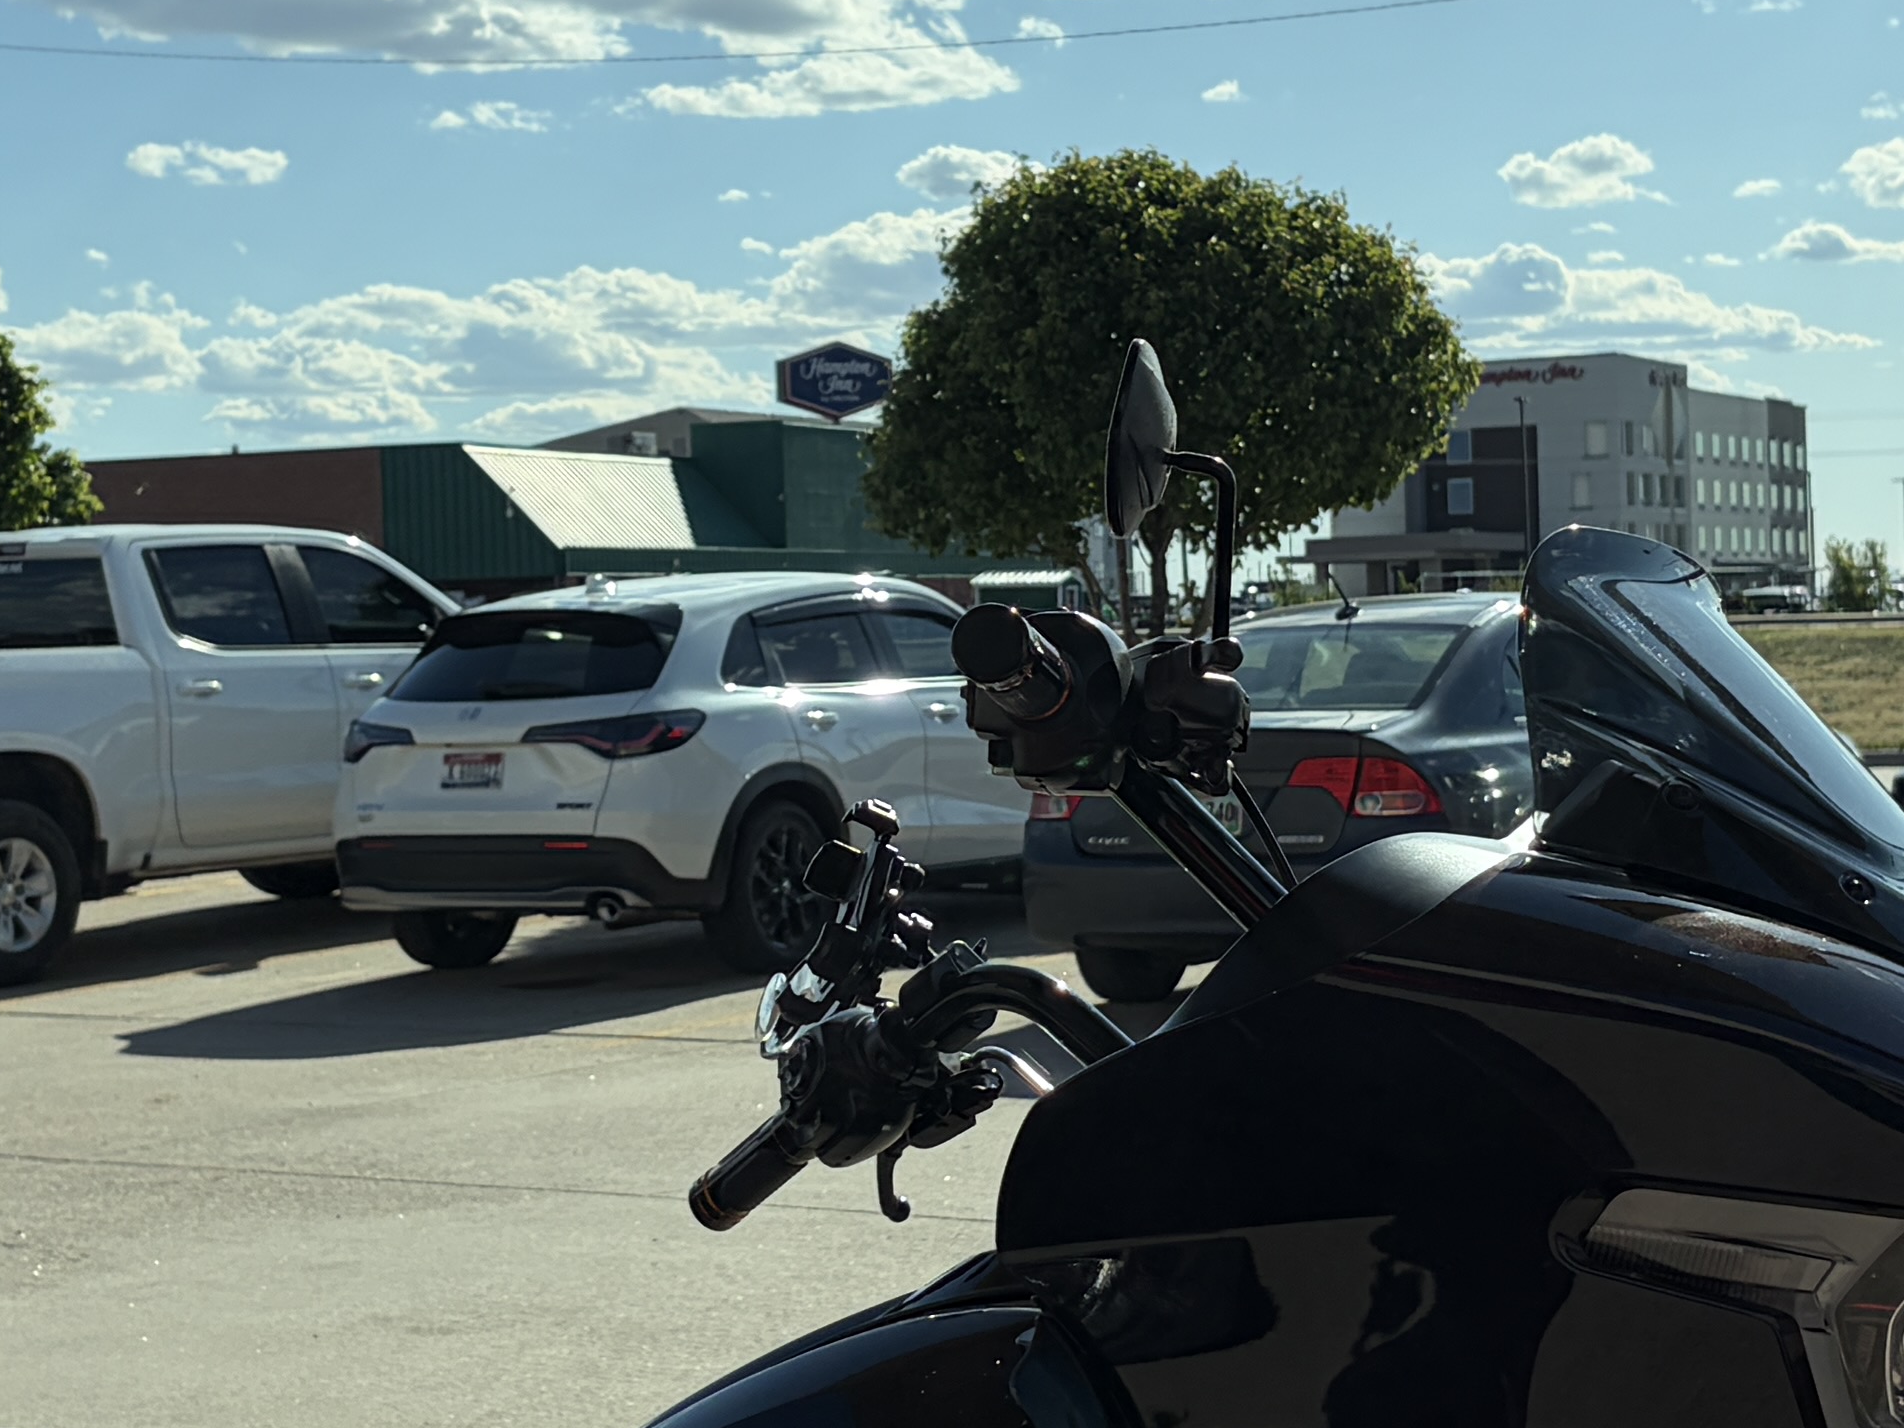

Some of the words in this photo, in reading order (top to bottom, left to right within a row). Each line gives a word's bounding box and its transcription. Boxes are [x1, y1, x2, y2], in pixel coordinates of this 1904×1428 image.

[800, 358, 876, 380] Hampton
[819, 376, 861, 394] Inn
[1087, 836, 1131, 845] CIVIC
